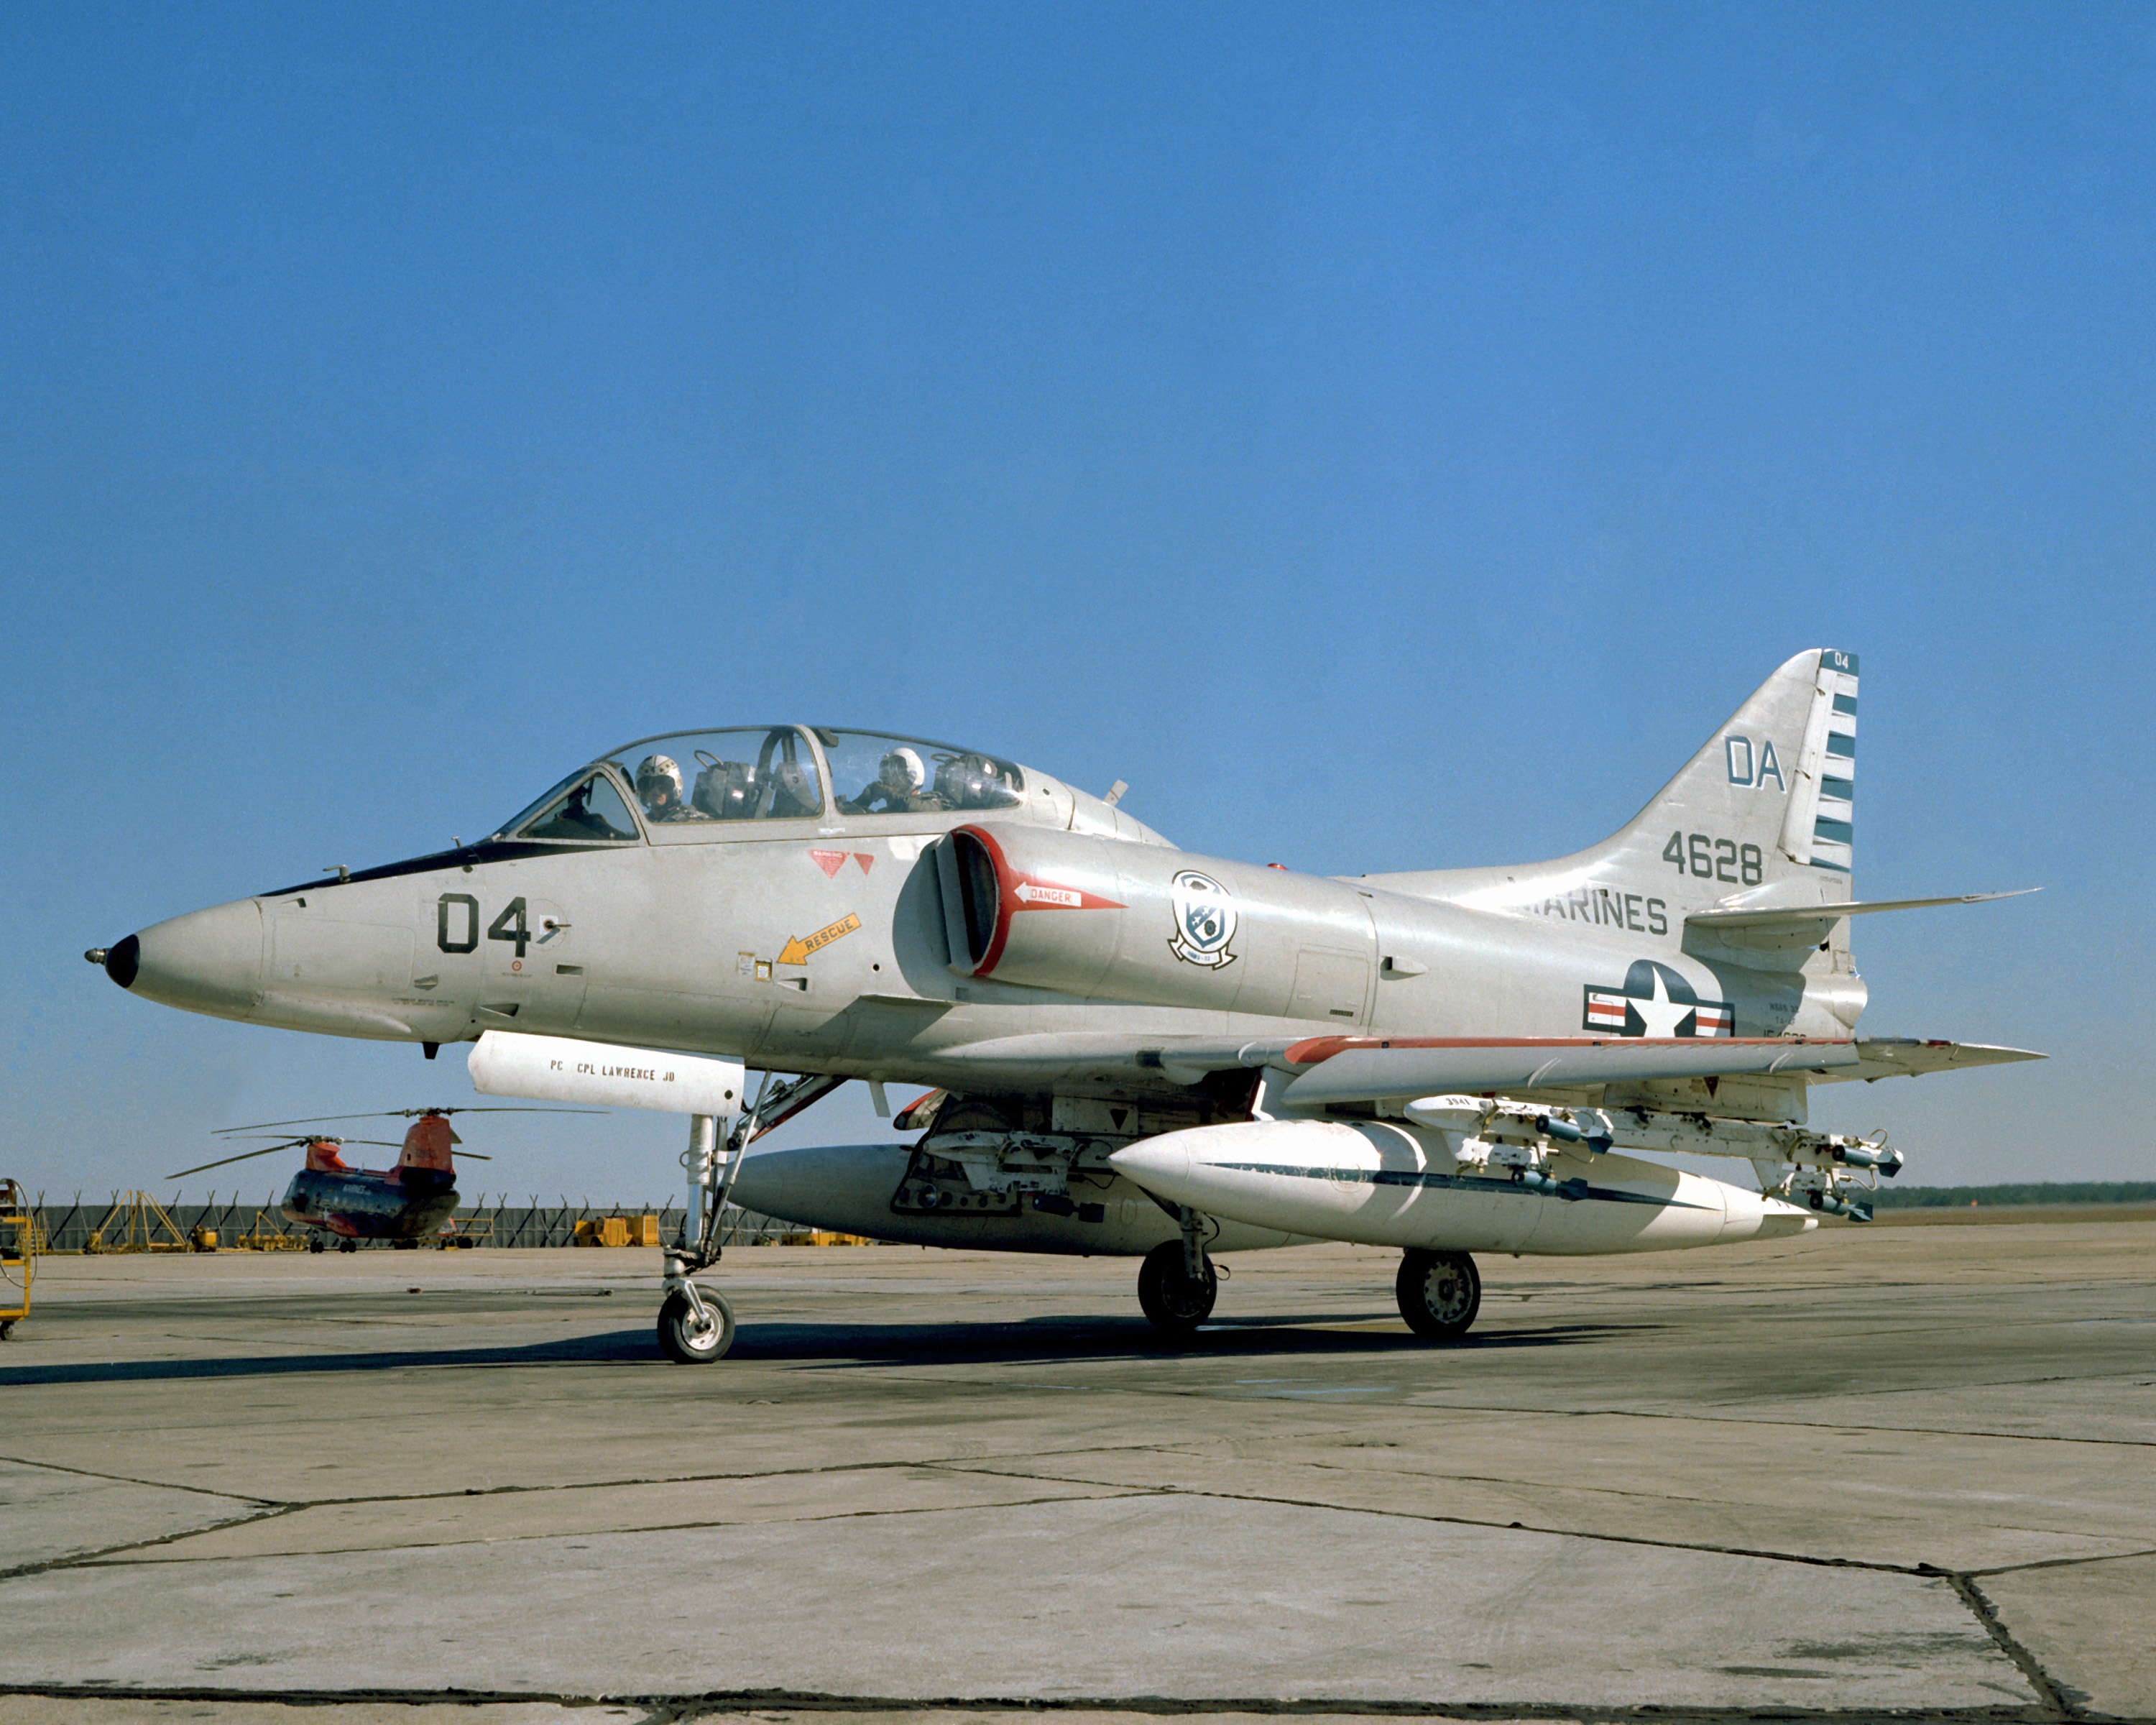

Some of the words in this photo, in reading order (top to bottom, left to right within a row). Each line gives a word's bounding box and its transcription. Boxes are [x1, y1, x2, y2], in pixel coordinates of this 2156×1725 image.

[1835, 653, 1848, 668] 04
[1726, 735, 1787, 794] DA
[1662, 831, 1762, 886] 4628
[1030, 888, 1072, 902] DANGER
[437, 893, 531, 958] 04
[805, 919, 853, 951] RESCUE
[550, 1059, 563, 1071] PC
[577, 1063, 595, 1075] CPL
[602, 1066, 655, 1081] LAWRENCE
[663, 1072, 675, 1082] JD
